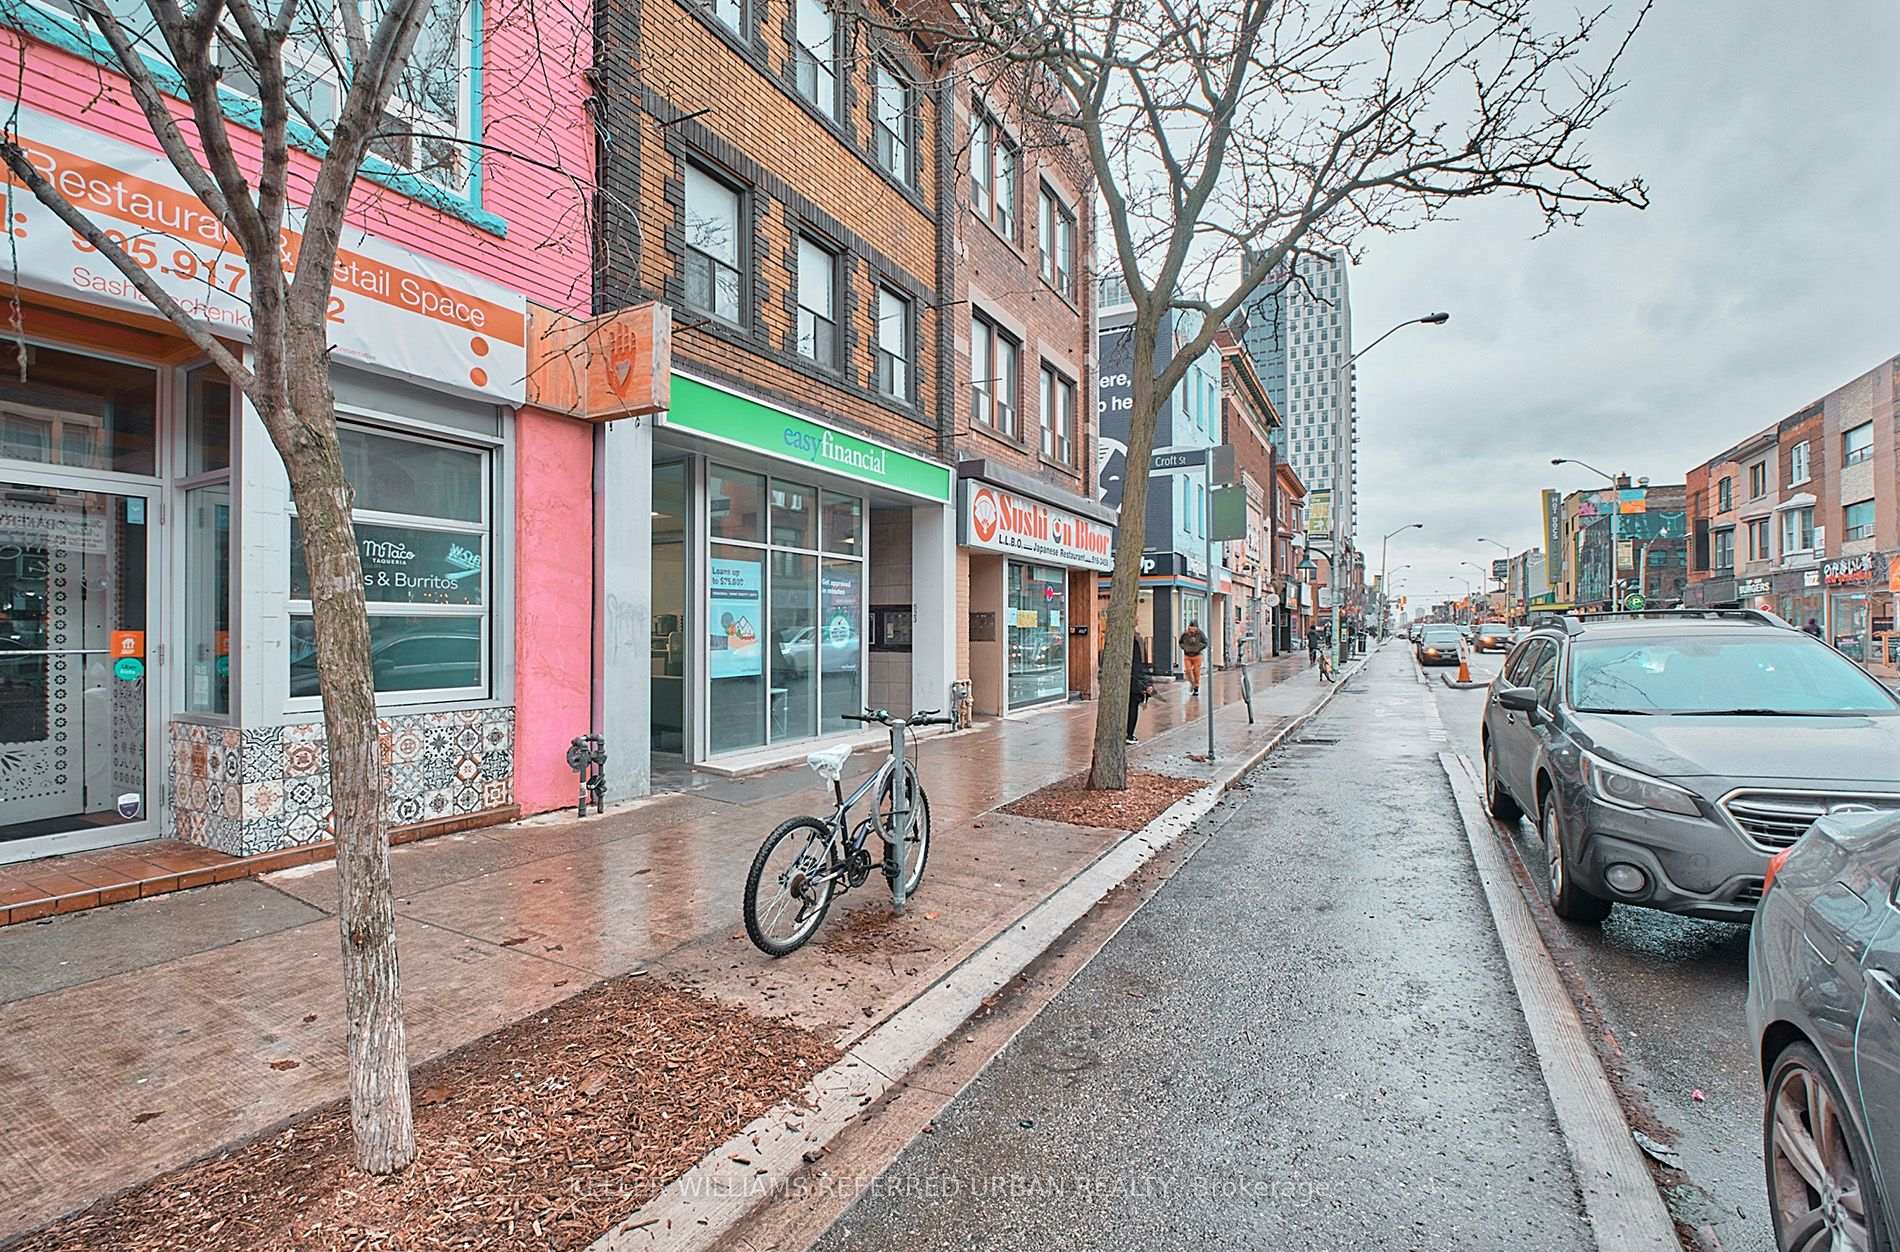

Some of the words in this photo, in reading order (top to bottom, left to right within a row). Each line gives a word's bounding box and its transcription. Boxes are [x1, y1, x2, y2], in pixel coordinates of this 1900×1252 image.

[25, 147, 230, 243] Restaura
[333, 257, 390, 296] etail
[400, 279, 485, 328] Space
[72, 266, 149, 301] Sash
[1099, 373, 1132, 389] ere,
[1111, 396, 1134, 411] he
[783, 426, 887, 476] easyfinancial
[1155, 454, 1177, 466] Croft
[1178, 456, 1186, 465] St
[999, 495, 1048, 541] Sushi
[1074, 518, 1110, 556] Bloor
[1551, 516, 1559, 540] DOCS
[1033, 543, 1060, 558] Japanese
[377, 571, 391, 587] &
[395, 572, 459, 590] Burritos
